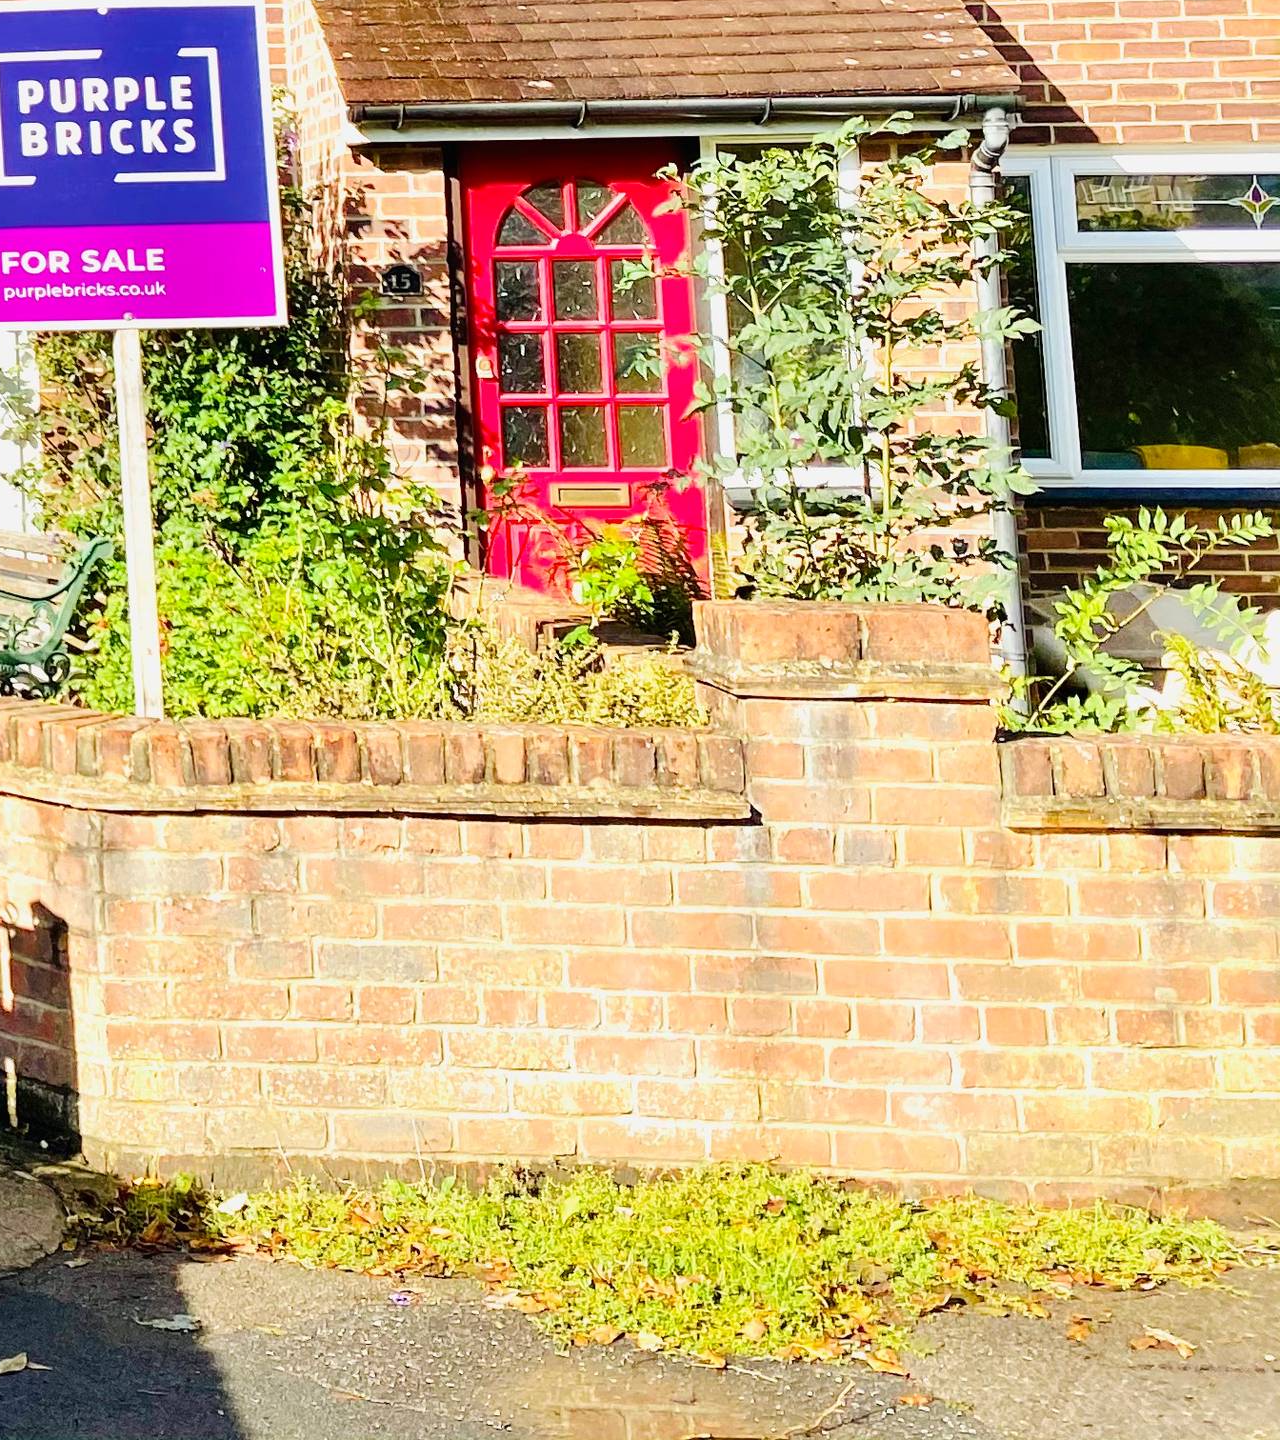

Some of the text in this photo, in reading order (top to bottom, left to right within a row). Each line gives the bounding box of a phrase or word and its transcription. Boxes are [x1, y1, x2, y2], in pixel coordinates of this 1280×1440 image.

[17, 75, 193, 114] PURPLE
[20, 118, 197, 157] BRICKS
[1, 248, 165, 275] FOR SALE
[3, 281, 166, 302] purplebricks.co.uk
[390, 273, 411, 289] 15
